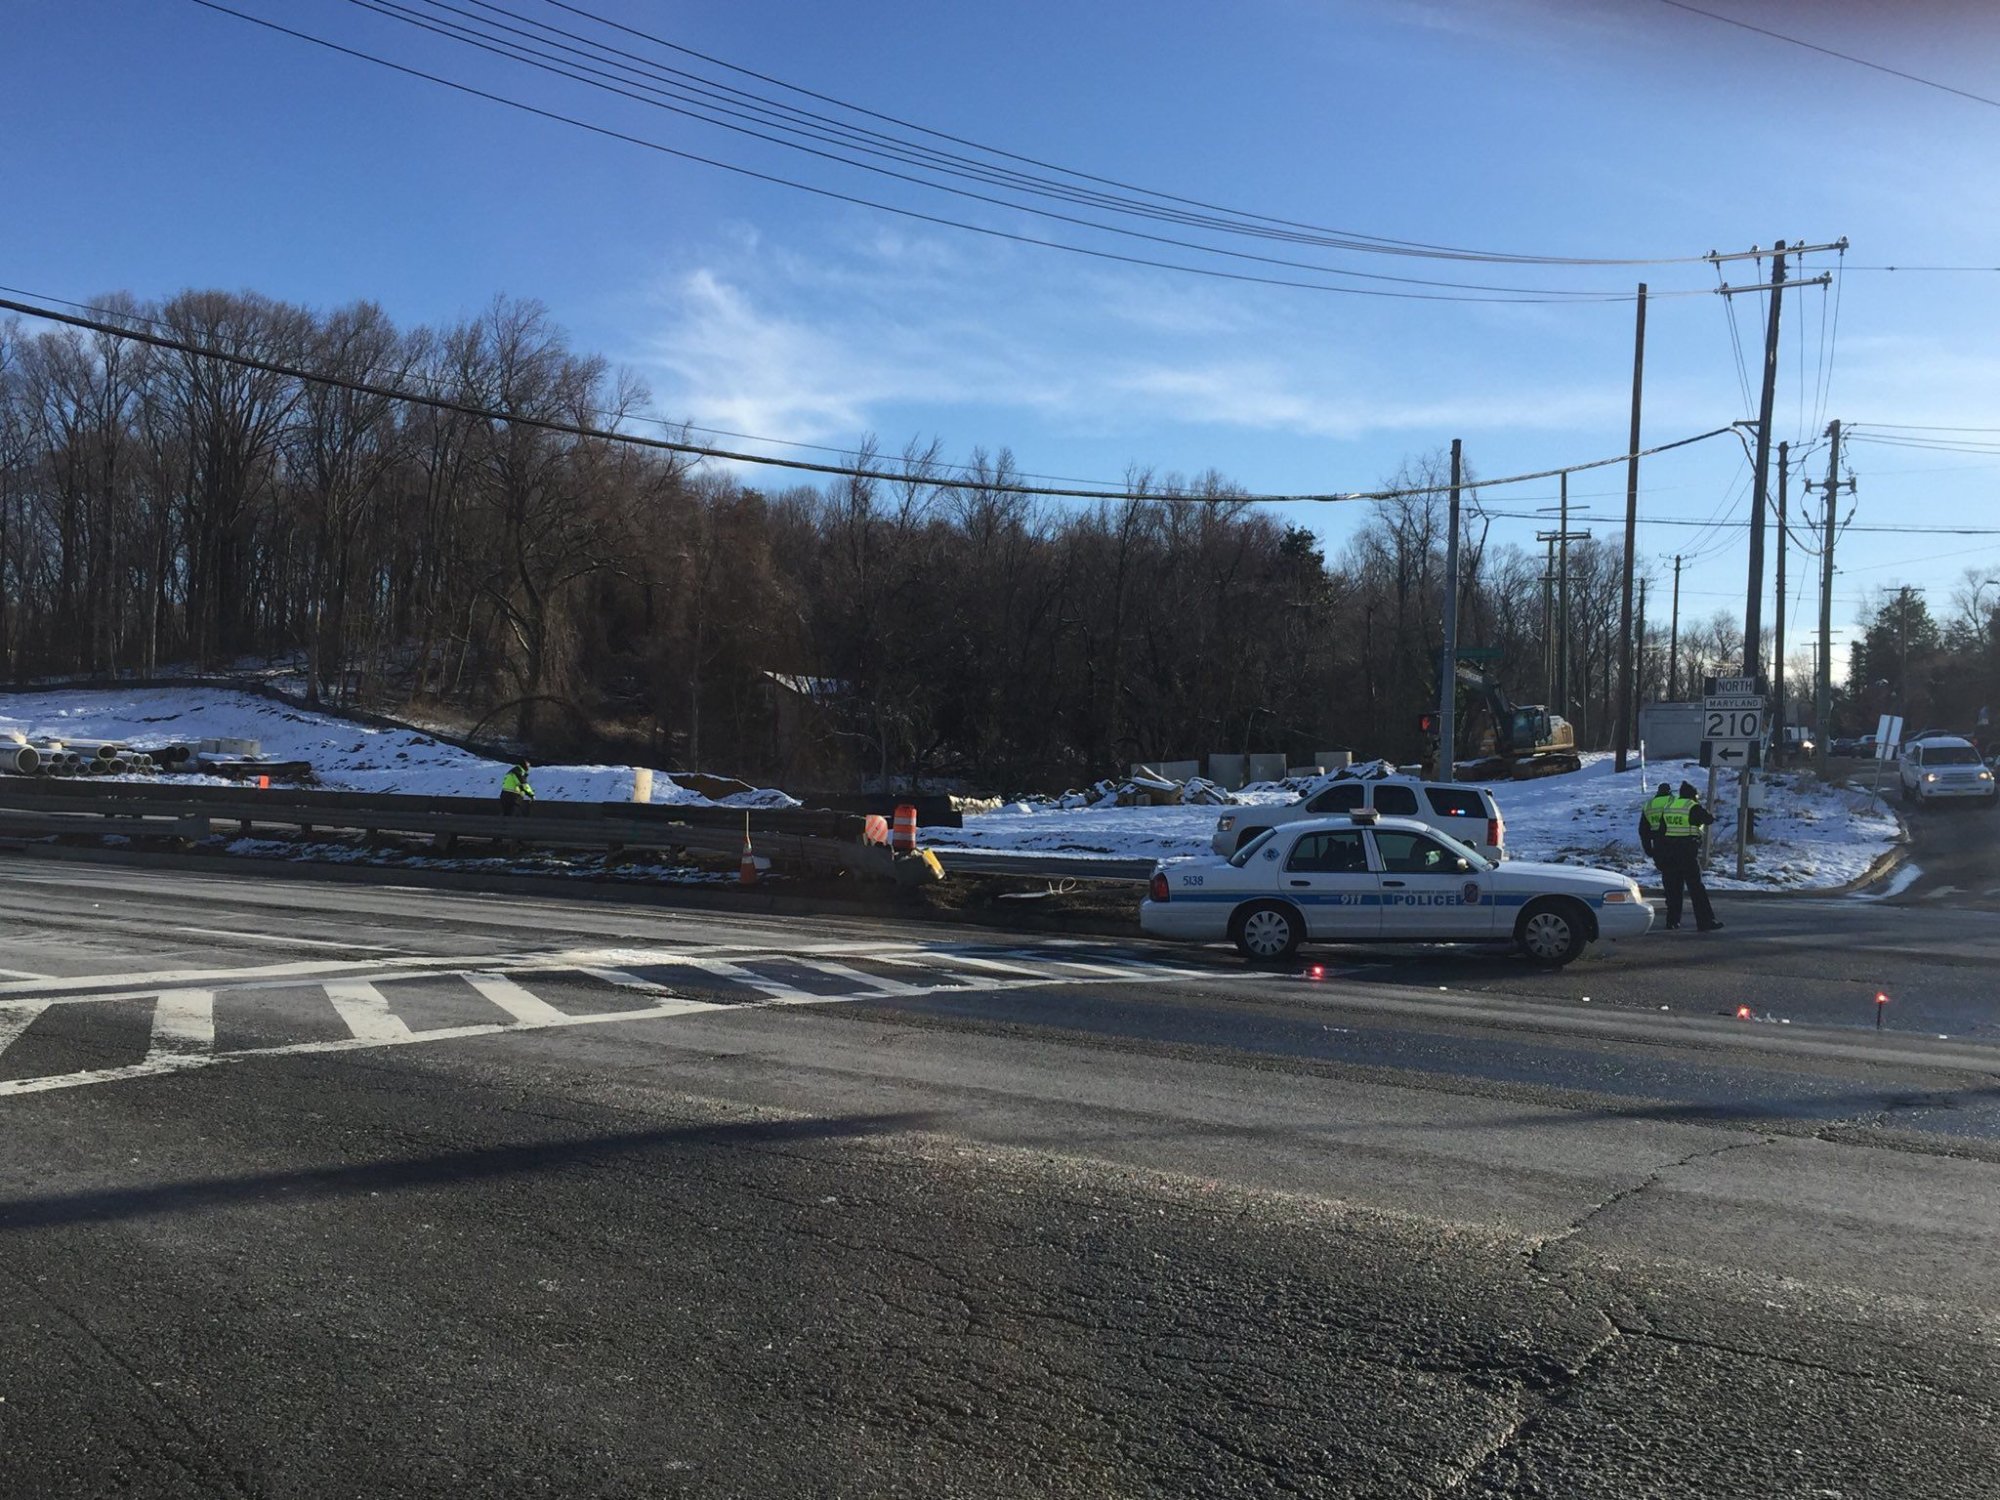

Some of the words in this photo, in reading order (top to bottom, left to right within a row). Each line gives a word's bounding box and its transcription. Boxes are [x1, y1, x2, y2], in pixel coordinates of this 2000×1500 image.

[1718, 680, 1752, 692] NORTH
[1707, 712, 1757, 737] 210
[1183, 875, 1204, 886] 5138
[1393, 894, 1456, 905] POLICE
